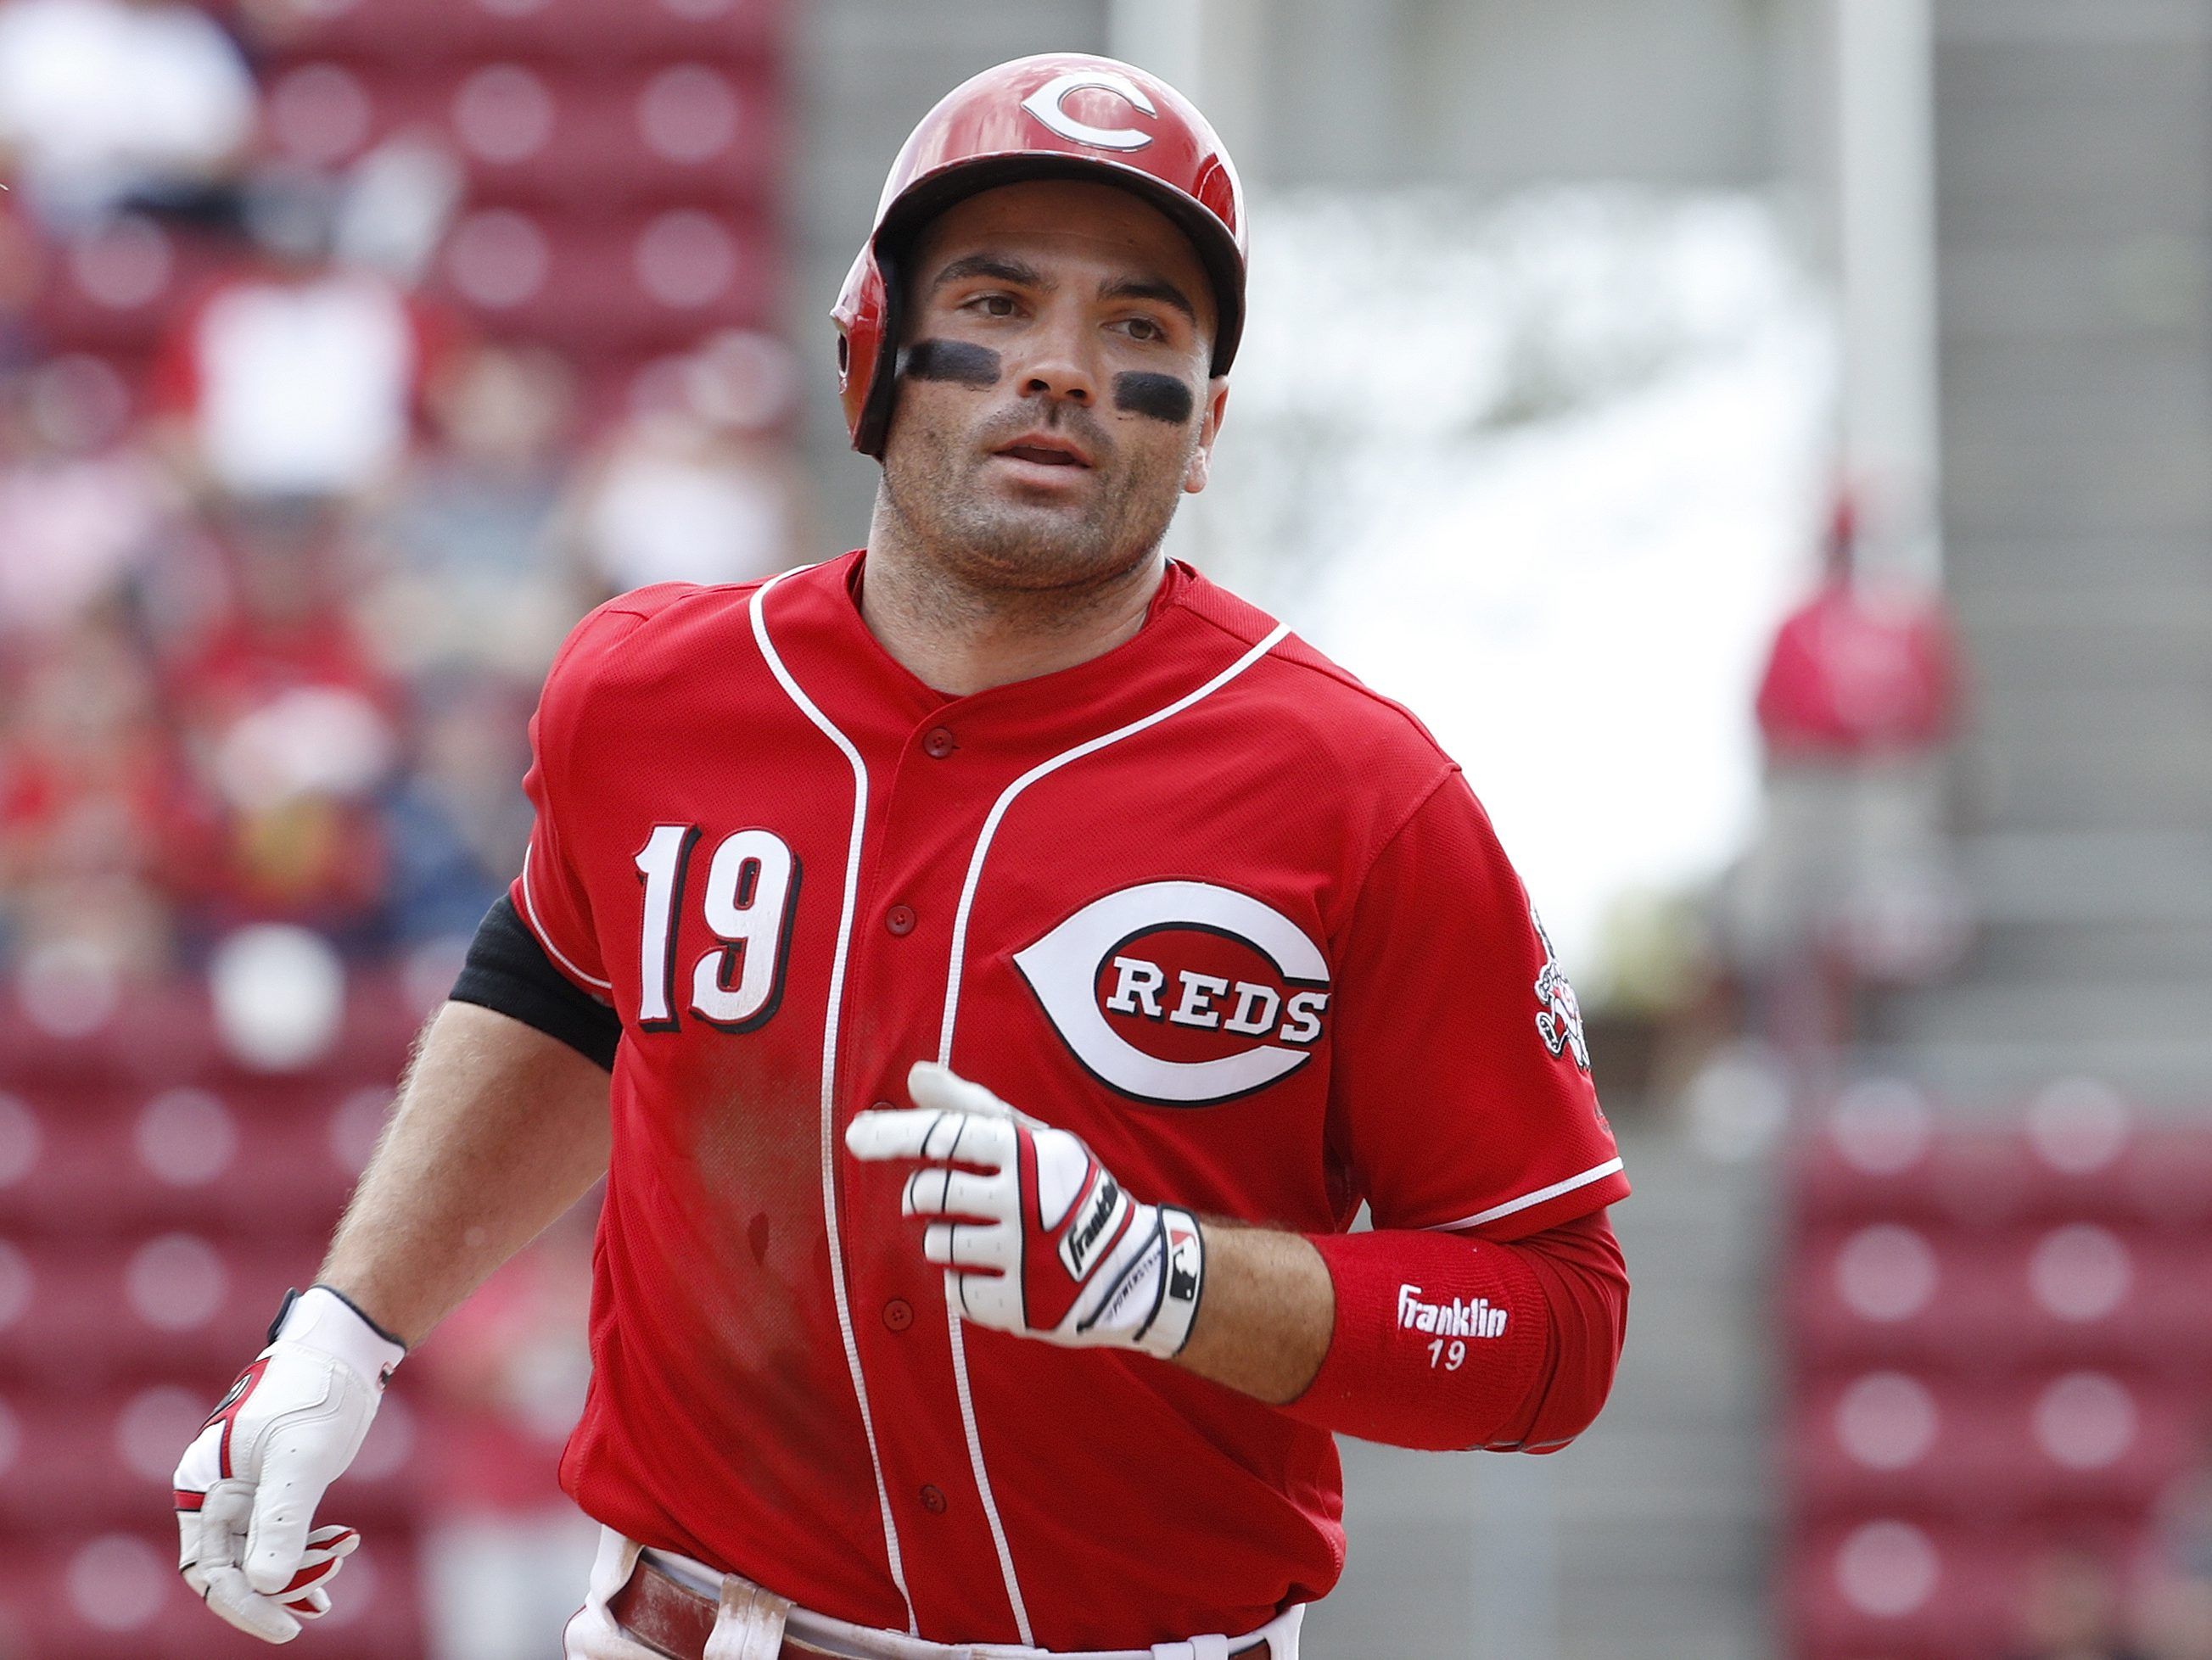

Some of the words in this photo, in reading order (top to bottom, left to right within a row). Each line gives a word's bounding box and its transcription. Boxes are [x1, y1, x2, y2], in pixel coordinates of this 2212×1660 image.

[1020, 71, 1157, 152] C
[632, 822, 805, 1035] 19
[1012, 877, 1330, 1106] C
[1106, 955, 1332, 1044] REDS
[1397, 1283, 1509, 1339] Franklin
[1427, 1339, 1467, 1372] 19
